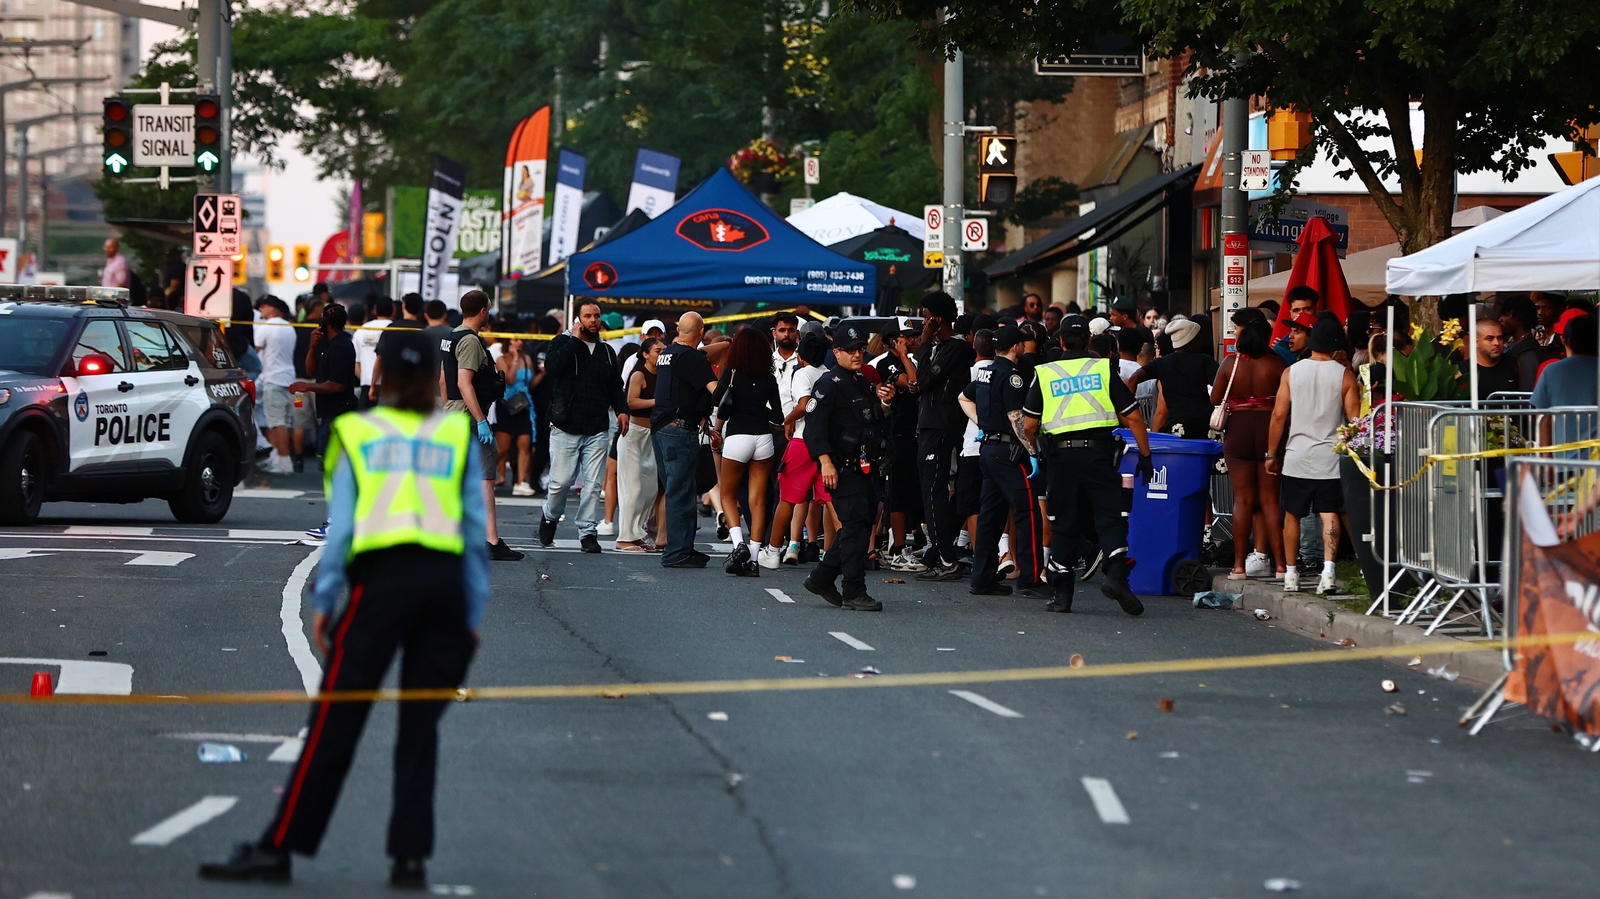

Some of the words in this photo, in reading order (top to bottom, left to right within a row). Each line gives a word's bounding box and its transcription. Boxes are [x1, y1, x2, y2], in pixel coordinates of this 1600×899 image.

[138, 115, 192, 132] TRANSIT
[141, 139, 189, 156] SIGNAL
[1251, 154, 1261, 164] NO
[1244, 166, 1268, 177] STANDING
[744, 275, 772, 285] ONSITE
[773, 276, 798, 286] MEDIC
[807, 270, 827, 280] (905)
[1230, 276, 1242, 284] 512
[806, 282, 864, 294] canaphem.ca
[440, 338, 452, 353] POLICE
[656, 353, 673, 366] POLICE
[976, 369, 993, 384] POLICE
[210, 382, 241, 398] PSRT17
[1051, 375, 1100, 396] POLICE
[95, 403, 128, 414] TORONTO
[94, 412, 171, 447] POLICE
